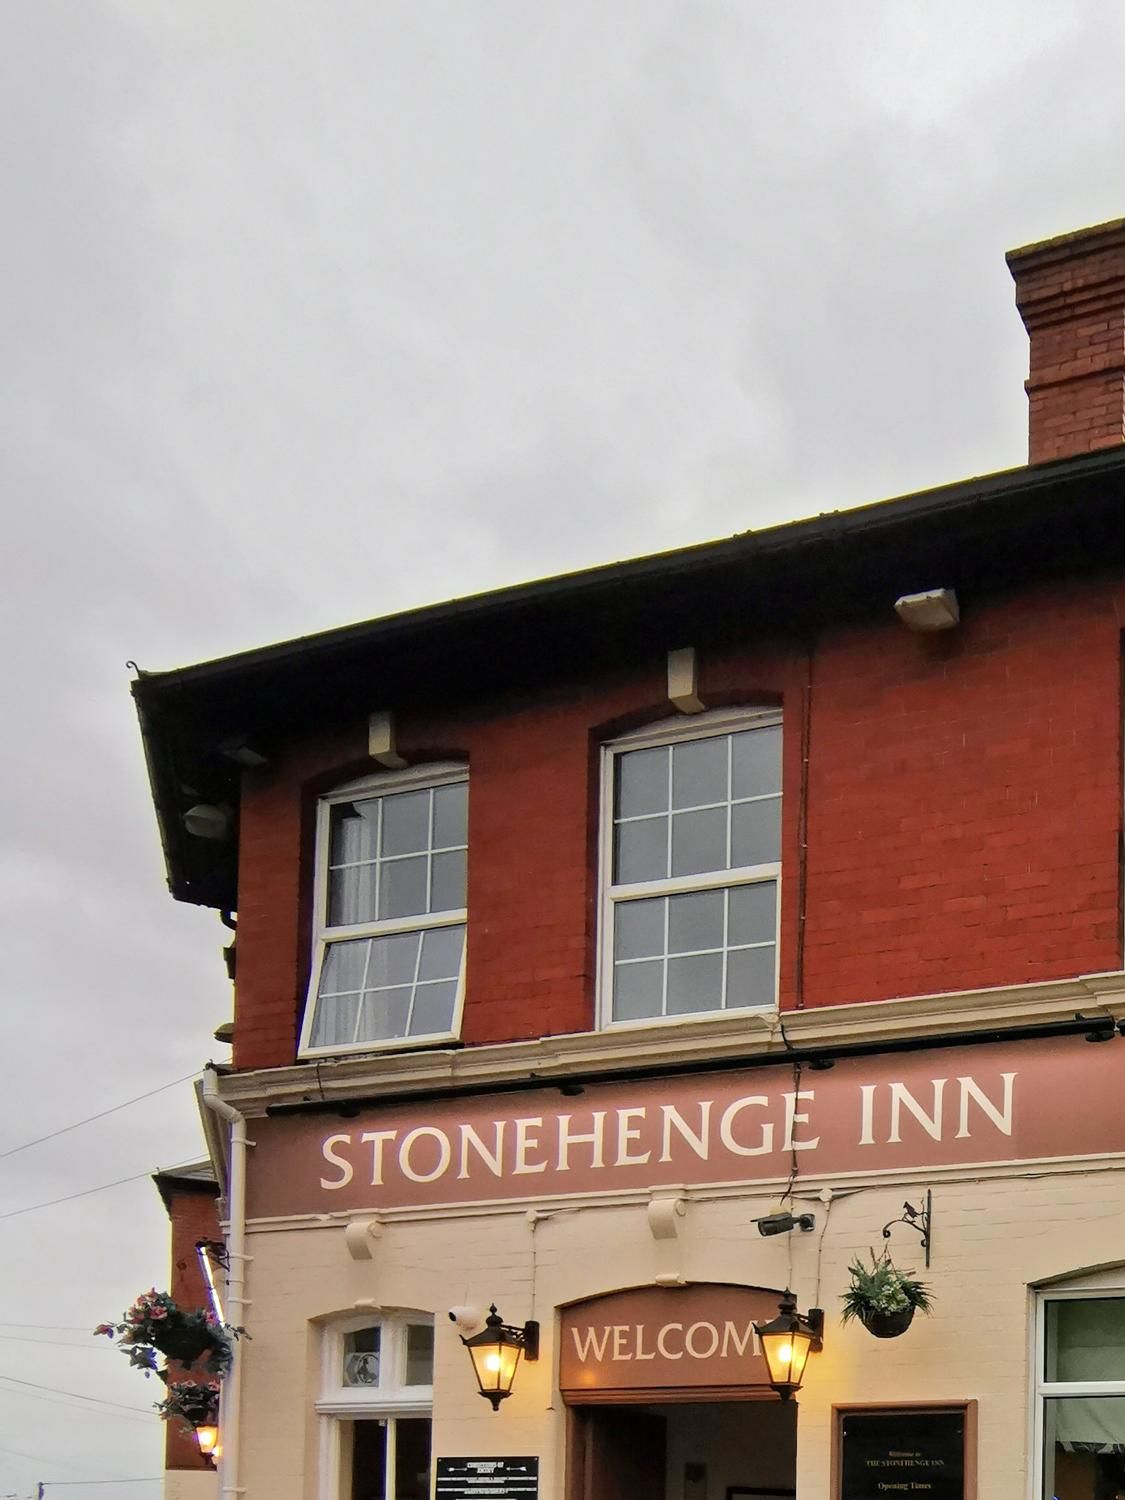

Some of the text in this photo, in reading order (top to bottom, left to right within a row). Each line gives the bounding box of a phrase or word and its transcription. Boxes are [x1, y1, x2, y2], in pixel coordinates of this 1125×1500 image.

[319, 1072, 1019, 1190] STONEHENGE INN
[571, 1320, 775, 1363] WELCOM
